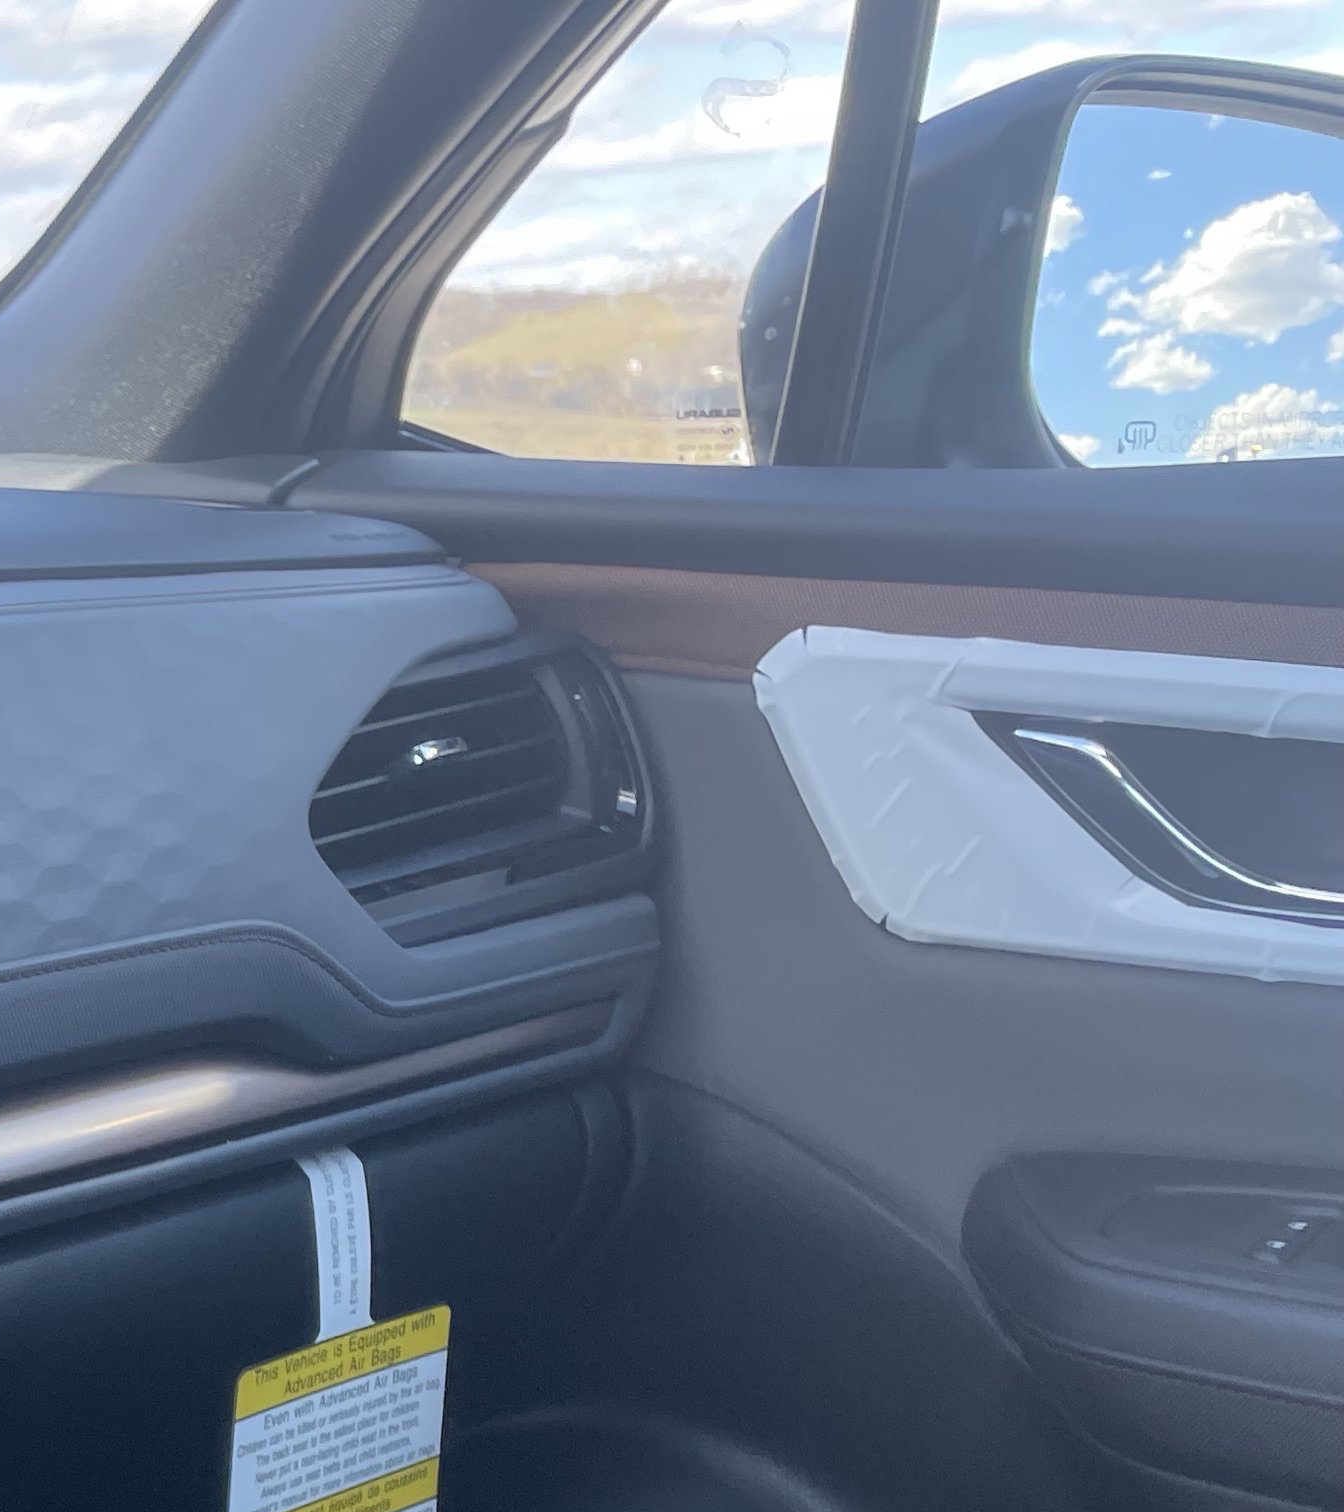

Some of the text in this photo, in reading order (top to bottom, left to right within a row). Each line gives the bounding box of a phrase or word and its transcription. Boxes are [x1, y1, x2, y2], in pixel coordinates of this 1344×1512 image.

[255, 1312, 435, 1384] This Vehicle is Equipped with
[284, 1342, 401, 1395] Advanced Air Bags
